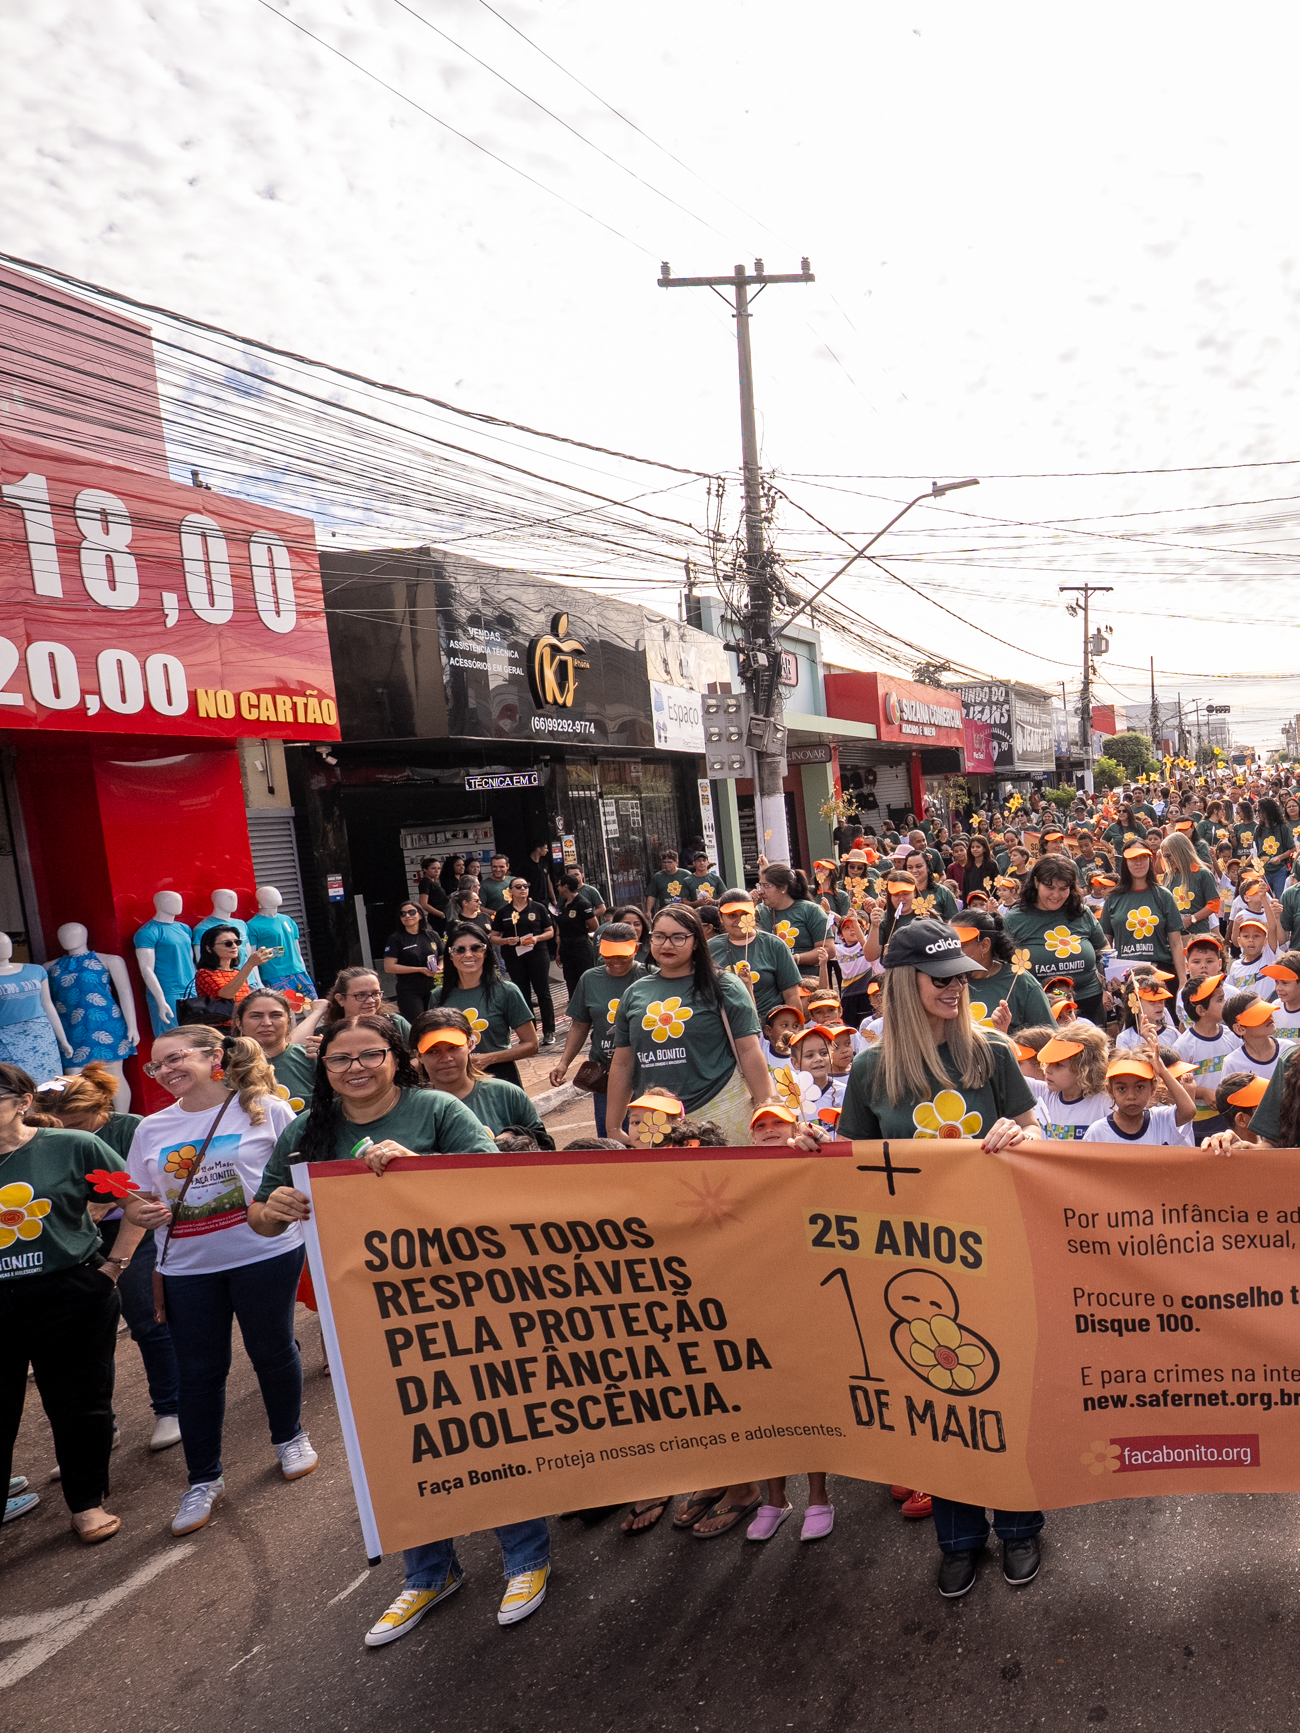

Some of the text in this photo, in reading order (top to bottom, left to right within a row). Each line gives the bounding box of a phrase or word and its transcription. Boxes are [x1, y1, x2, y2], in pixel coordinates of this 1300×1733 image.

[1, 472, 297, 634] 18,00
[468, 627, 500, 642] VENDAS
[491, 645, 519, 659] TÉCNICA
[450, 656, 524, 676] ACESSÓRIOS EM GERAL
[196, 688, 337, 726] NO CARTÃO
[991, 687, 1005, 702] DO
[667, 696, 699, 730] Espaço
[903, 698, 930, 724] SUZANA
[531, 716, 595, 734] (66)99292-9774
[792, 749, 825, 760] INOVAR
[470, 776, 512, 789] TÉCNICA
[513, 775, 529, 785] EM
[1058, 960, 1085, 971] BONITO
[656, 1047, 687, 1061] BONITO
[1063, 1207, 1099, 1229] Por
[1106, 1208, 1154, 1228] uma
[1161, 1203, 1249, 1225] infância
[1256, 1209, 1269, 1224] e
[363, 1217, 655, 1273] SOMOS TODOS
[808, 1213, 983, 1270] 25 ANOS
[1067, 1238, 1110, 1255] sem
[1117, 1231, 1215, 1256] violência
[1221, 1230, 1297, 1250] sexual,
[0, 1251, 43, 1272] ONITO
[373, 1253, 692, 1320] RESPONSÁVEIS
[1073, 1287, 1155, 1307] Procure
[1162, 1294, 1174, 1307] o
[1181, 1285, 1284, 1310] conselho
[384, 1290, 728, 1368] PELA PROTEÇÃO
[820, 1267, 1001, 1397] 18
[1075, 1313, 1201, 1337] Disque 100.
[395, 1337, 773, 1416] DA INFÂNCIA E DA
[1080, 1366, 1092, 1386] E
[1101, 1367, 1147, 1389] para
[1153, 1363, 1225, 1383] crimes
[1231, 1366, 1256, 1382] na
[411, 1381, 742, 1464] ADOLESCÊNCIA.
[848, 1384, 1007, 1453] DE MAIO
[417, 1423, 847, 1498] Faça Bonito. Proteja nossas crianças e adolescentes.
[1123, 1444, 1251, 1466] facabonito.org
